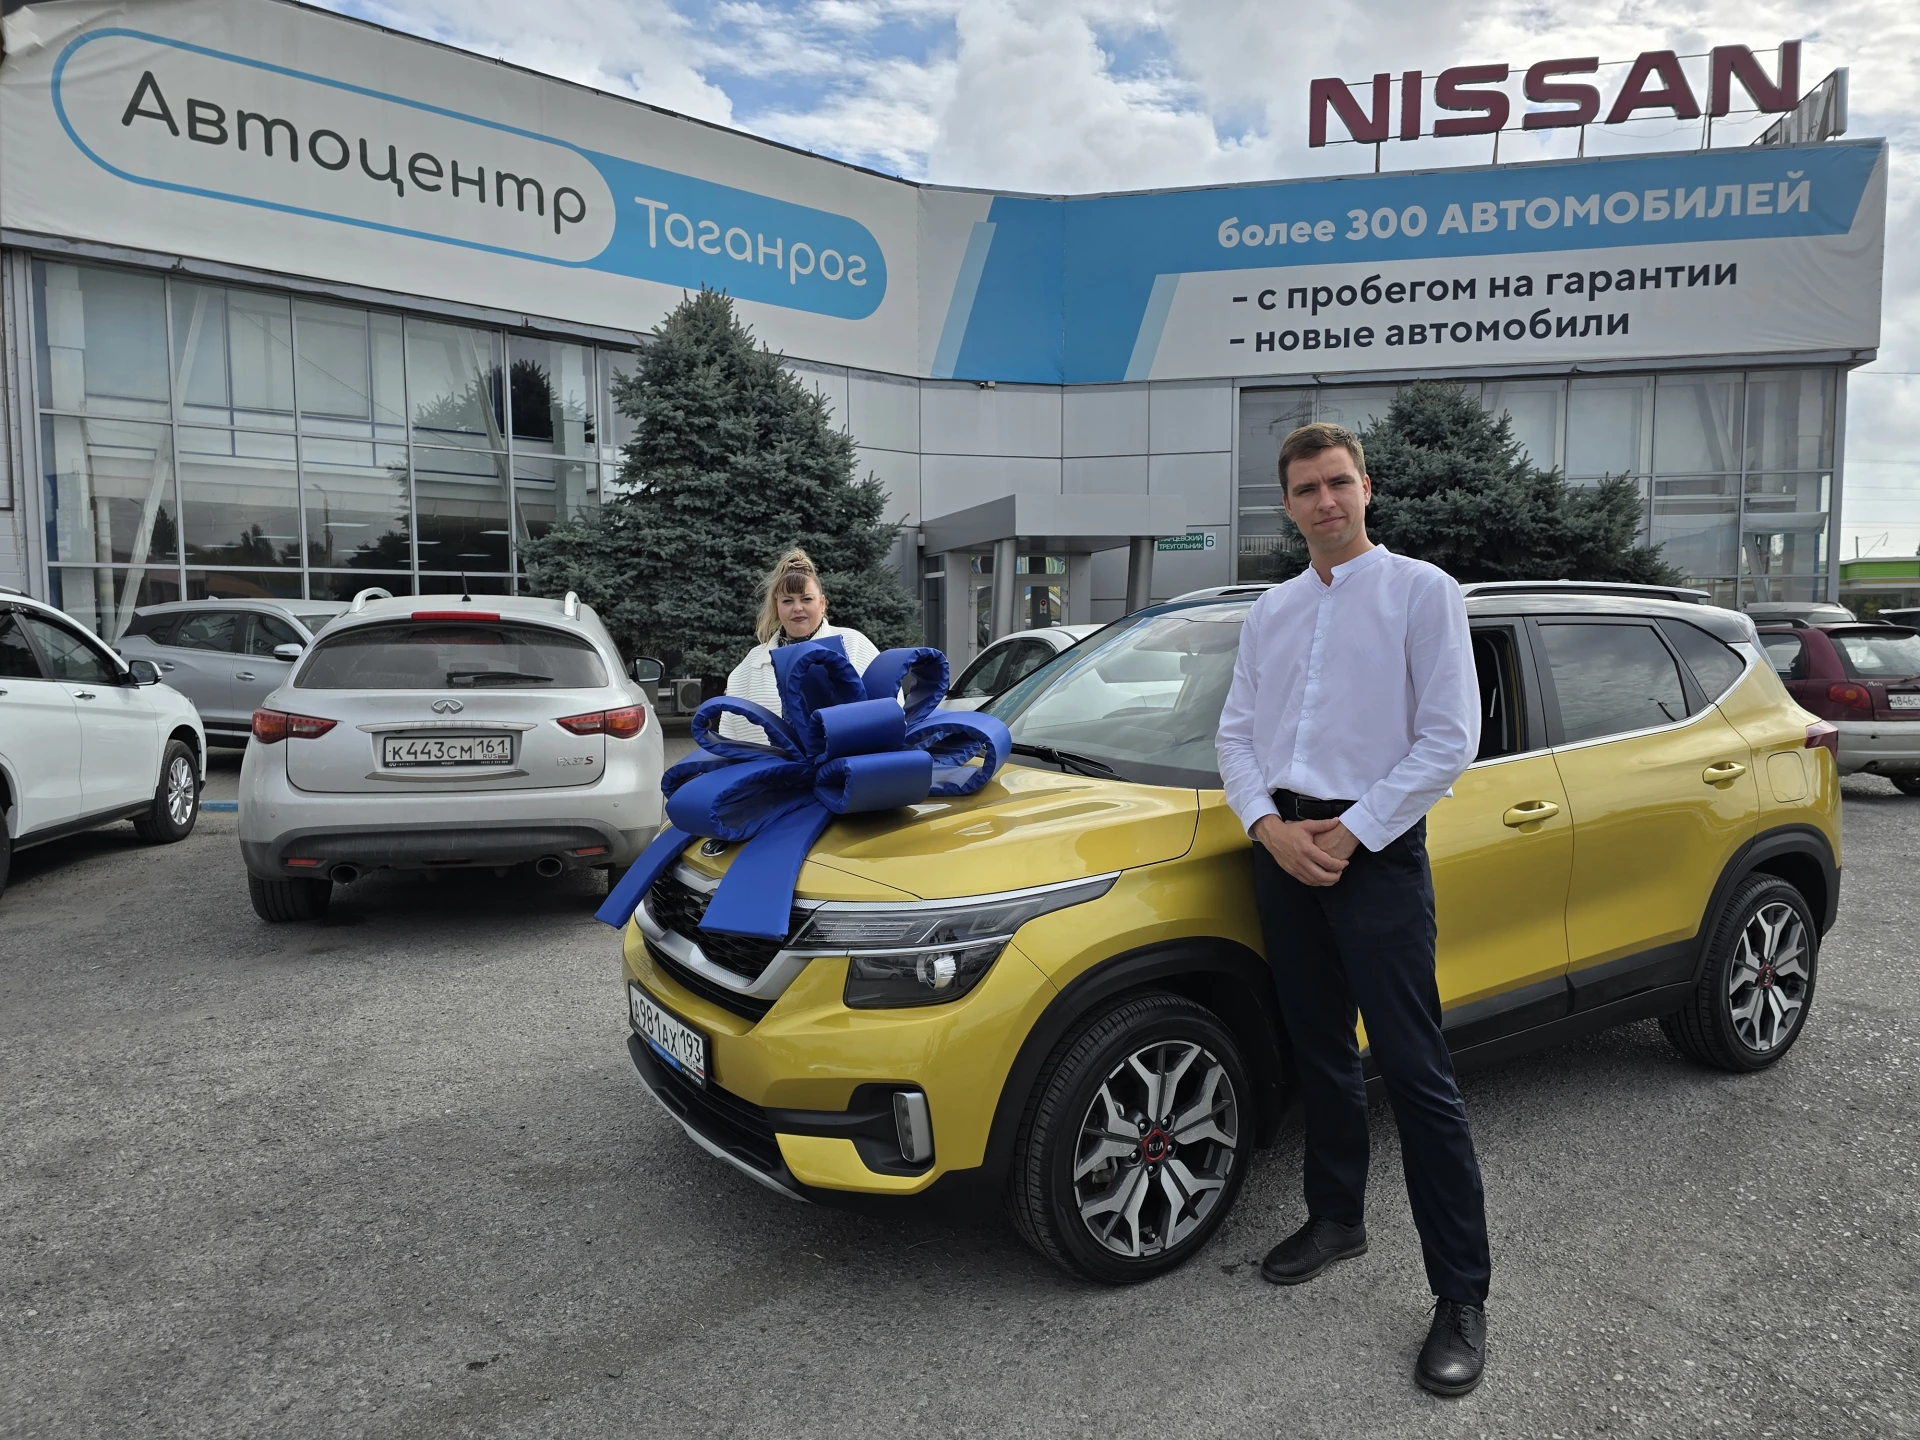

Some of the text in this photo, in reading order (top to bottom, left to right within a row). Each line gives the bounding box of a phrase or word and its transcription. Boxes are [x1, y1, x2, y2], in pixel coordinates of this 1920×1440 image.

[1309, 39, 1802, 148] NISSAN
[121, 70, 586, 235] Автоцентр
[1217, 168, 1812, 249] более 300 АВТОМОБИЛЕЙ
[634, 196, 867, 287] Таганрог
[1257, 289, 1277, 311] с
[1287, 273, 1477, 317] пробегом
[1489, 274, 1534, 299] на
[1546, 262, 1738, 302] гарантии
[1255, 326, 1375, 353] новые
[1385, 307, 1629, 347] автомобили
[1205, 535, 1215, 547] 6
[476, 739, 505, 754] 161
[679, 1029, 702, 1063] 193
[1149, 1141, 1164, 1151] KIA
